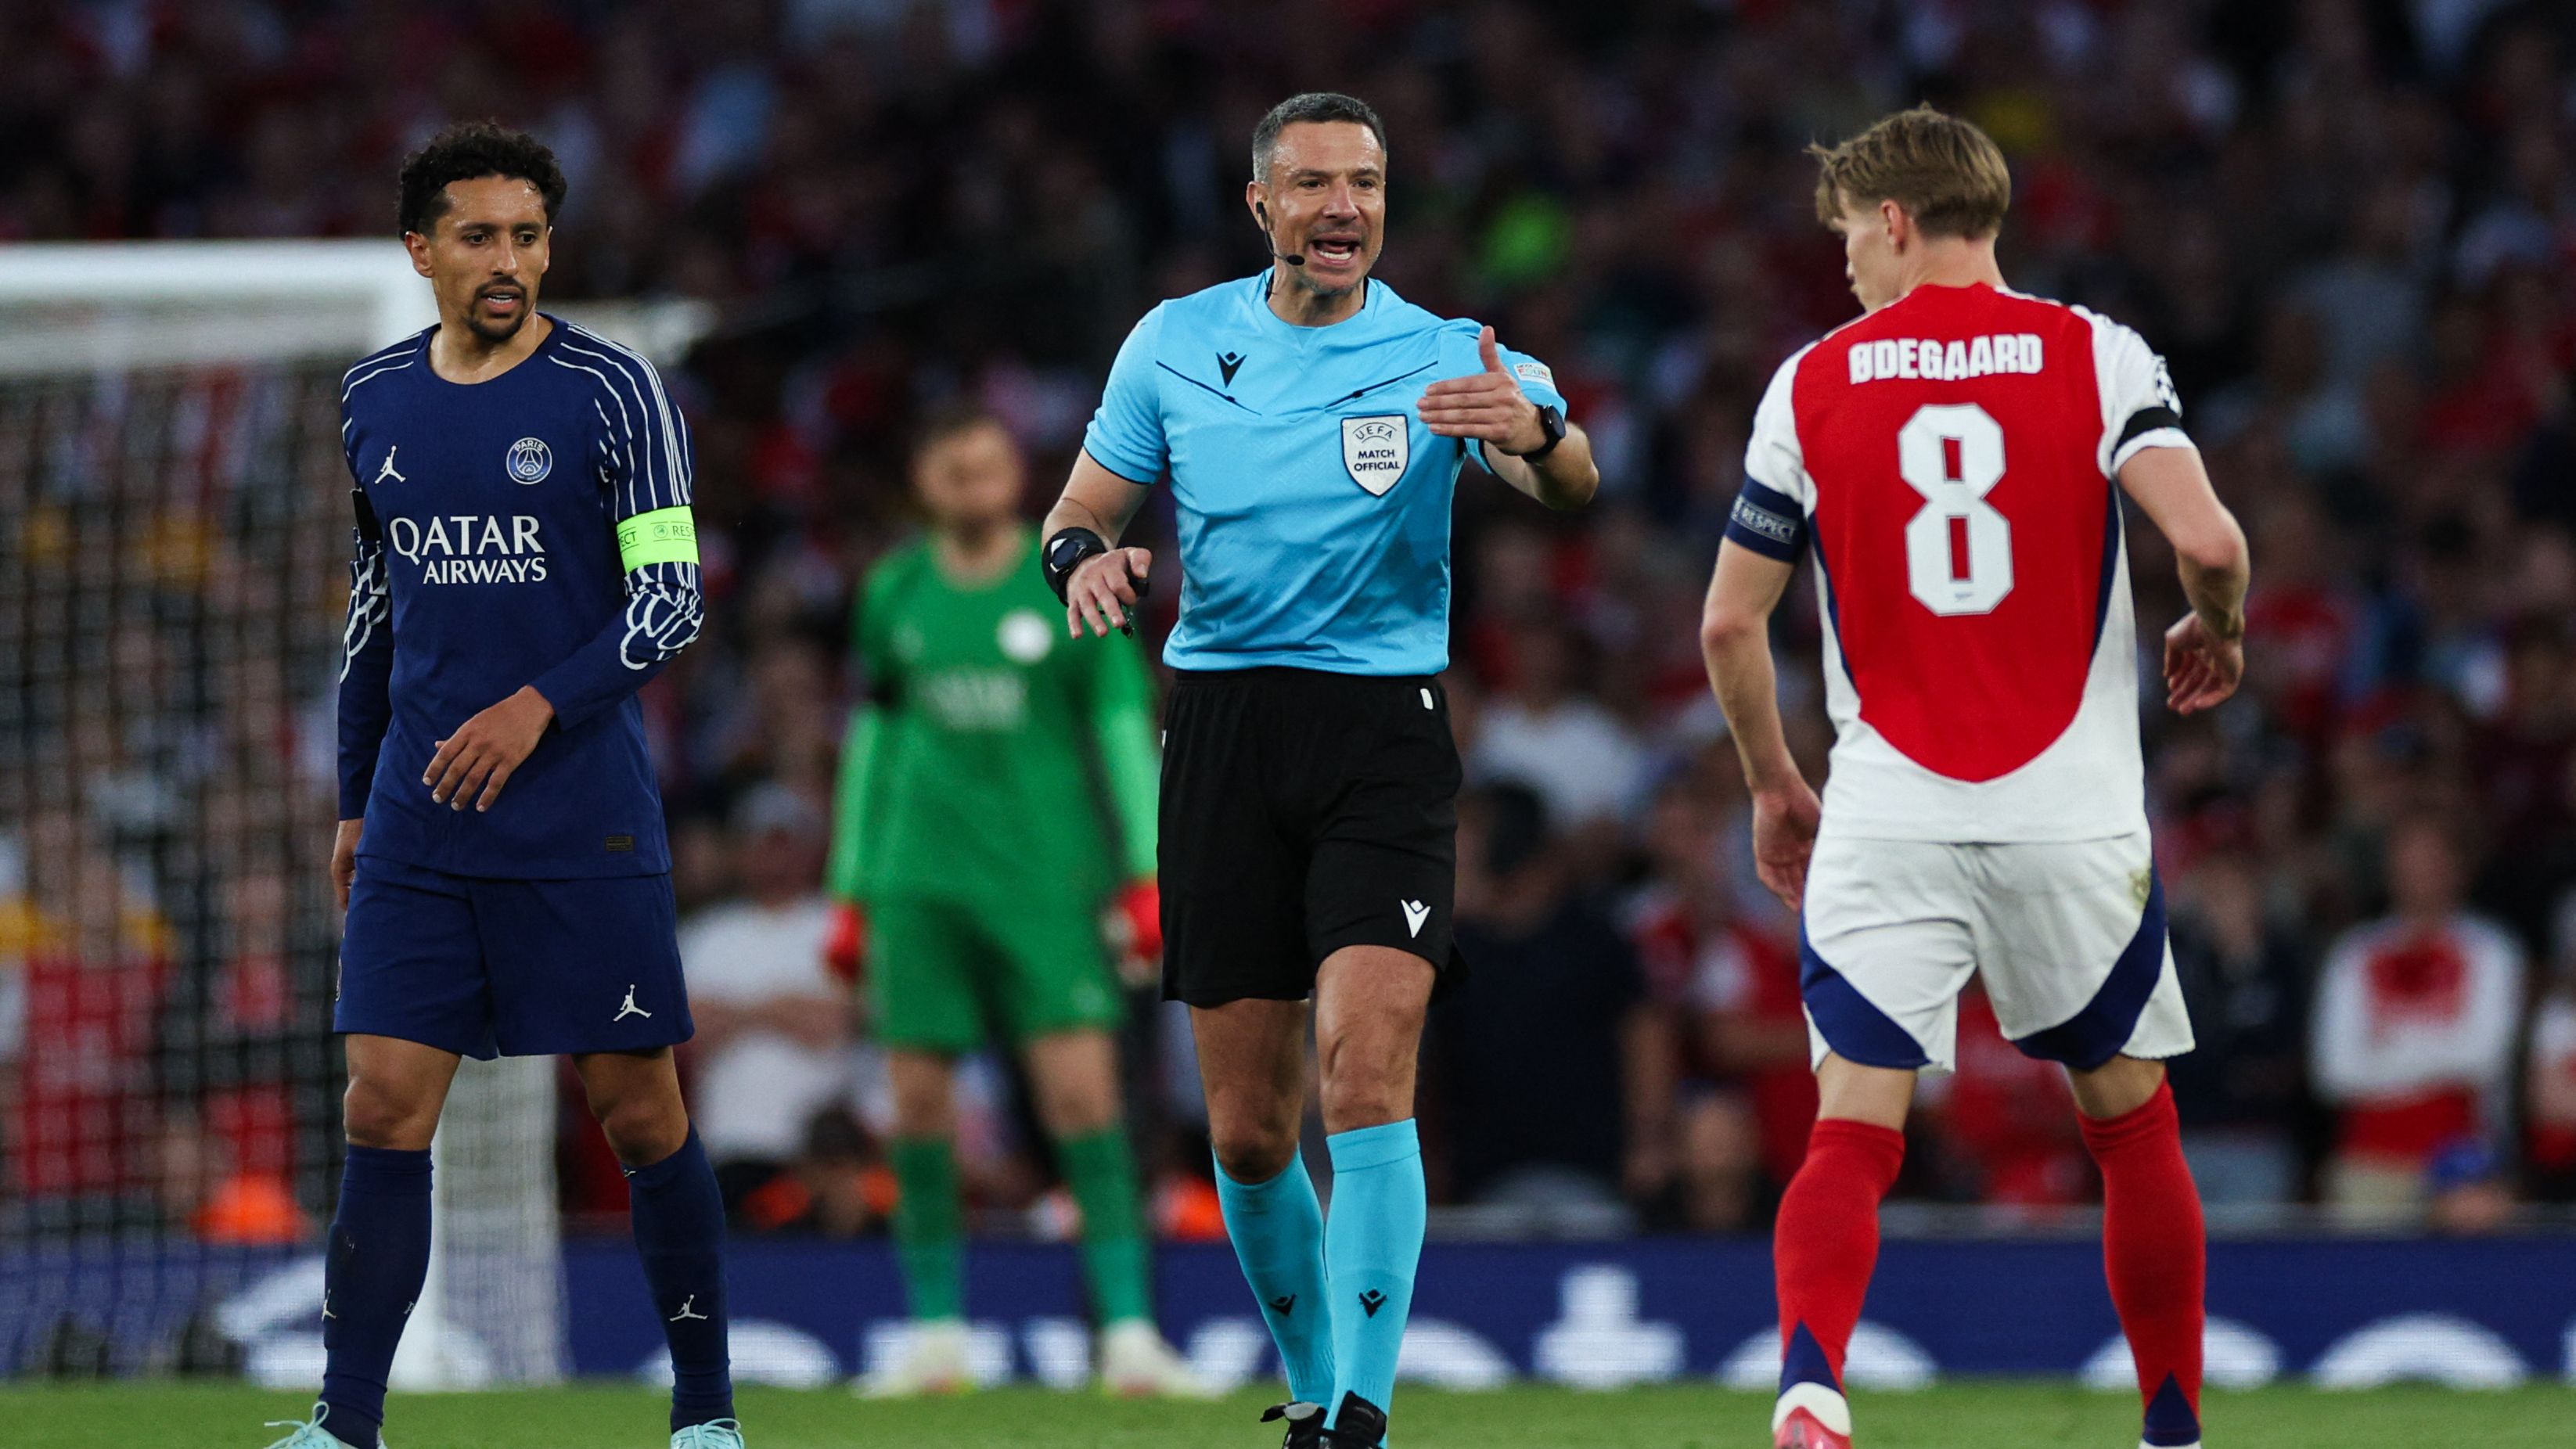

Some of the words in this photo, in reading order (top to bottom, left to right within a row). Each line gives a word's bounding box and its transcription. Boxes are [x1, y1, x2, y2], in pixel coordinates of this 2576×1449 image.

[1848, 333, 2043, 385] ØDEGAARD
[1355, 426, 1393, 440] UEFA
[514, 440, 545, 451] PARIS
[1358, 449, 1395, 459] MATCH
[1354, 461, 1400, 472] OFFICIAL
[1897, 402, 2014, 617] 8
[390, 515, 545, 566] QATAR
[423, 557, 547, 585] AIRWAYS
